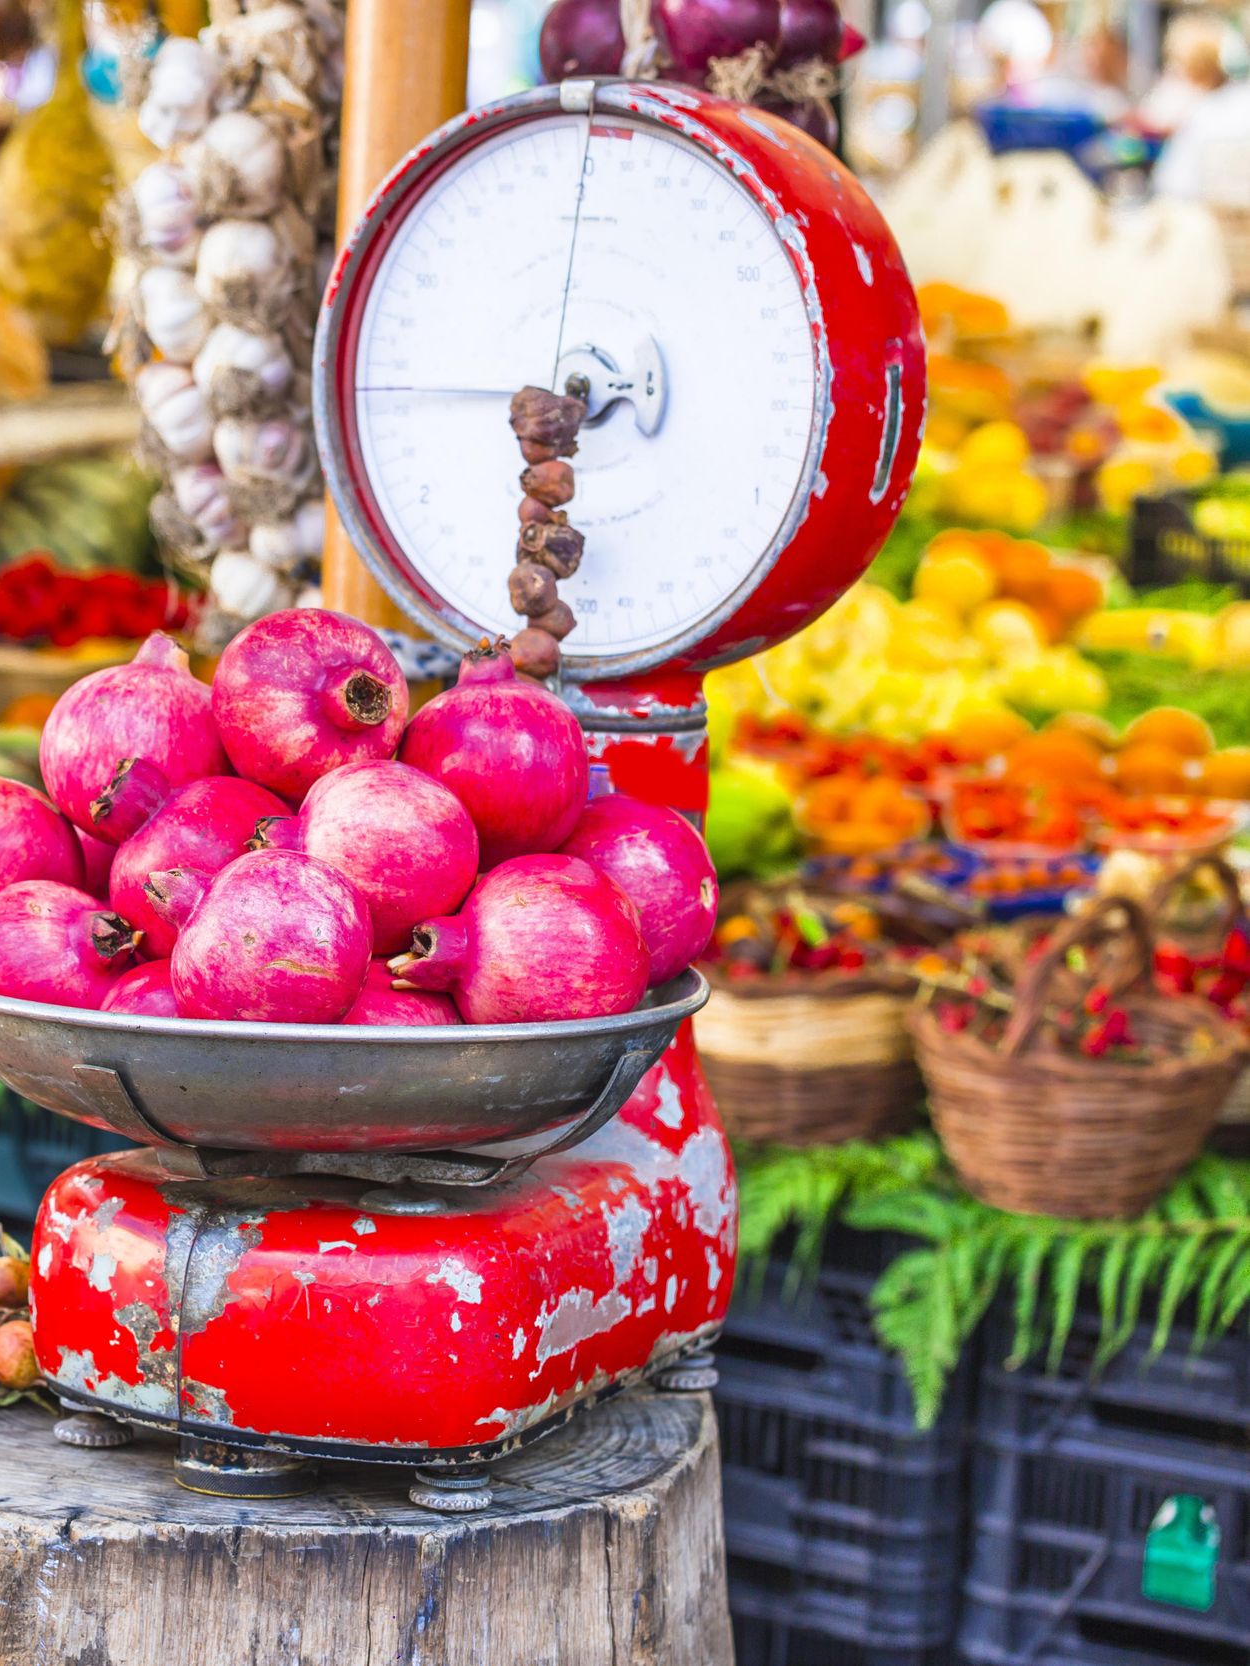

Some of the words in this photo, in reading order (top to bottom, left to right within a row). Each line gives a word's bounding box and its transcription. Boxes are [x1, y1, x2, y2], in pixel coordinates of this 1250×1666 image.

[583, 156, 595, 177] 0
[737, 265, 761, 283] 500
[419, 483, 431, 505] 2
[754, 486, 759, 506] 1
[575, 597, 598, 614] 500
